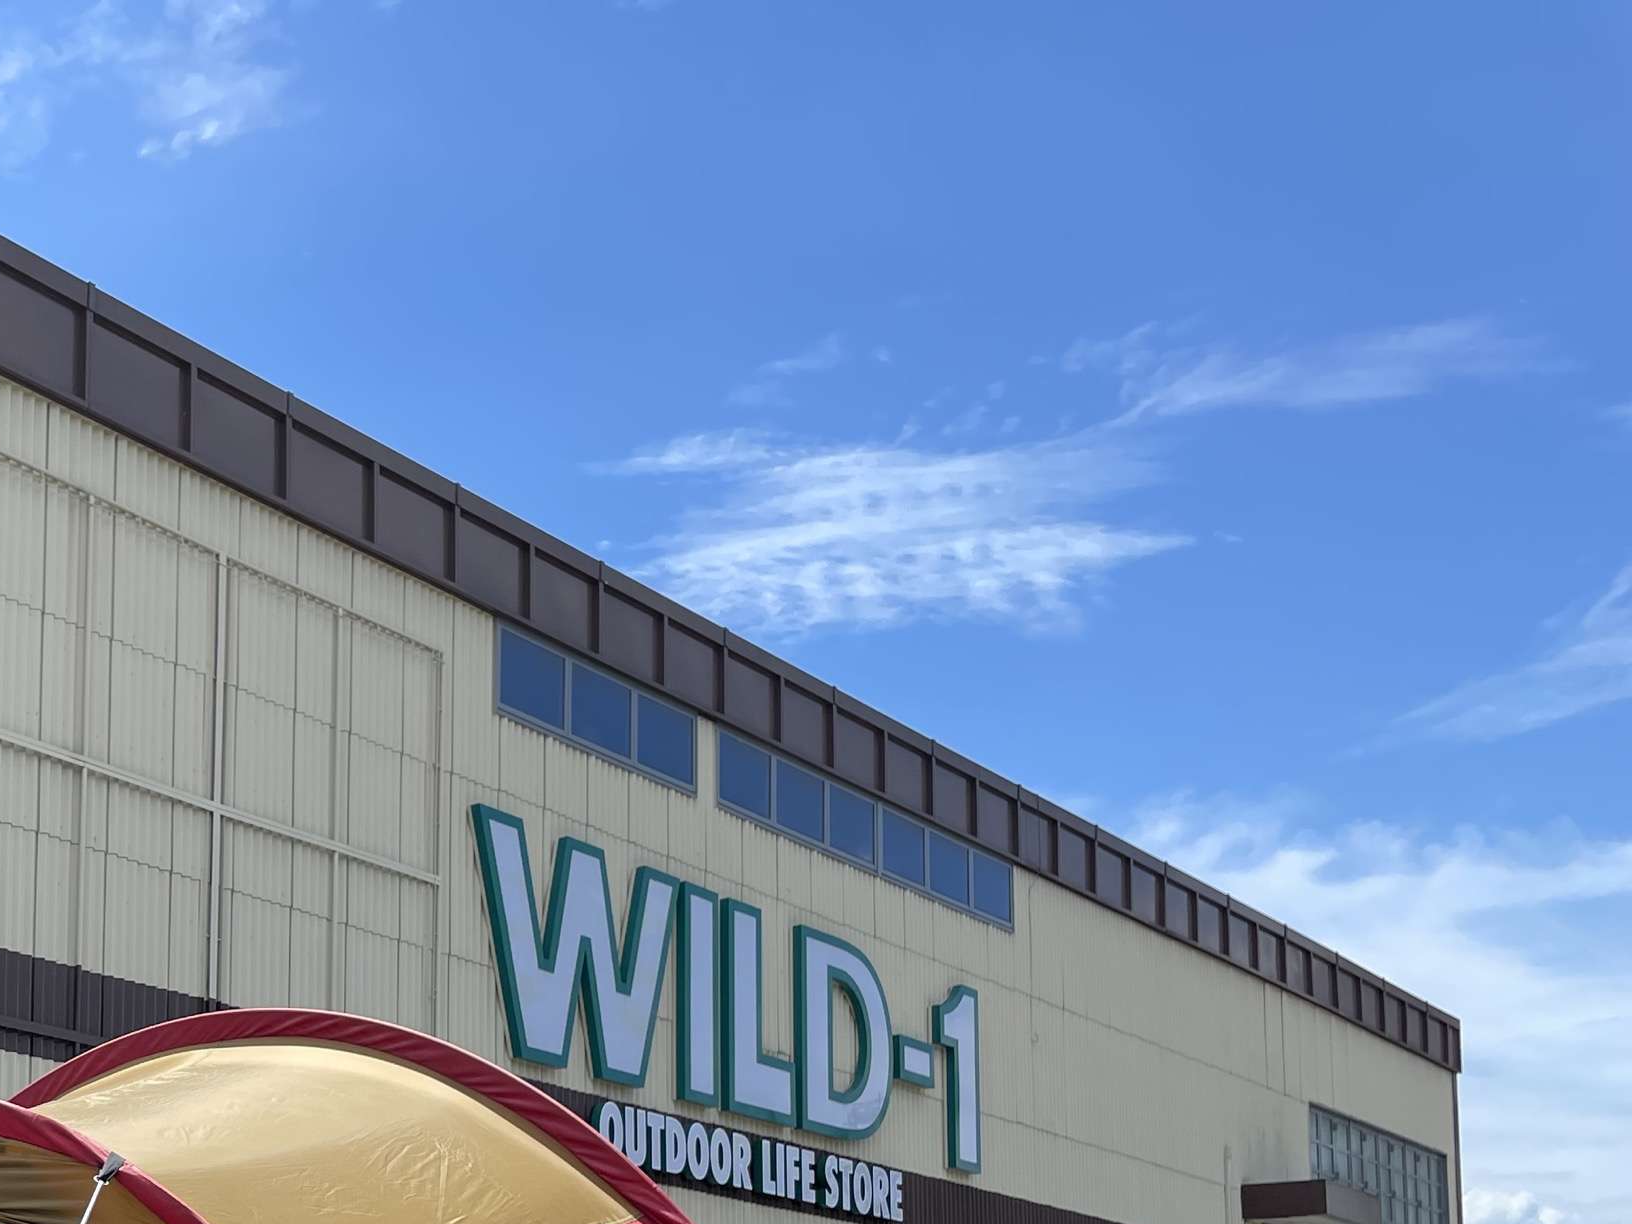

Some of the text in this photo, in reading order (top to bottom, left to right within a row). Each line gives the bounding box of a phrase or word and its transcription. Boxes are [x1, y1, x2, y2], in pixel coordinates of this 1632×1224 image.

[470, 803, 983, 1174] WILD-1
[596, 1101, 905, 1223] OUTDOOR LIFE STORE
